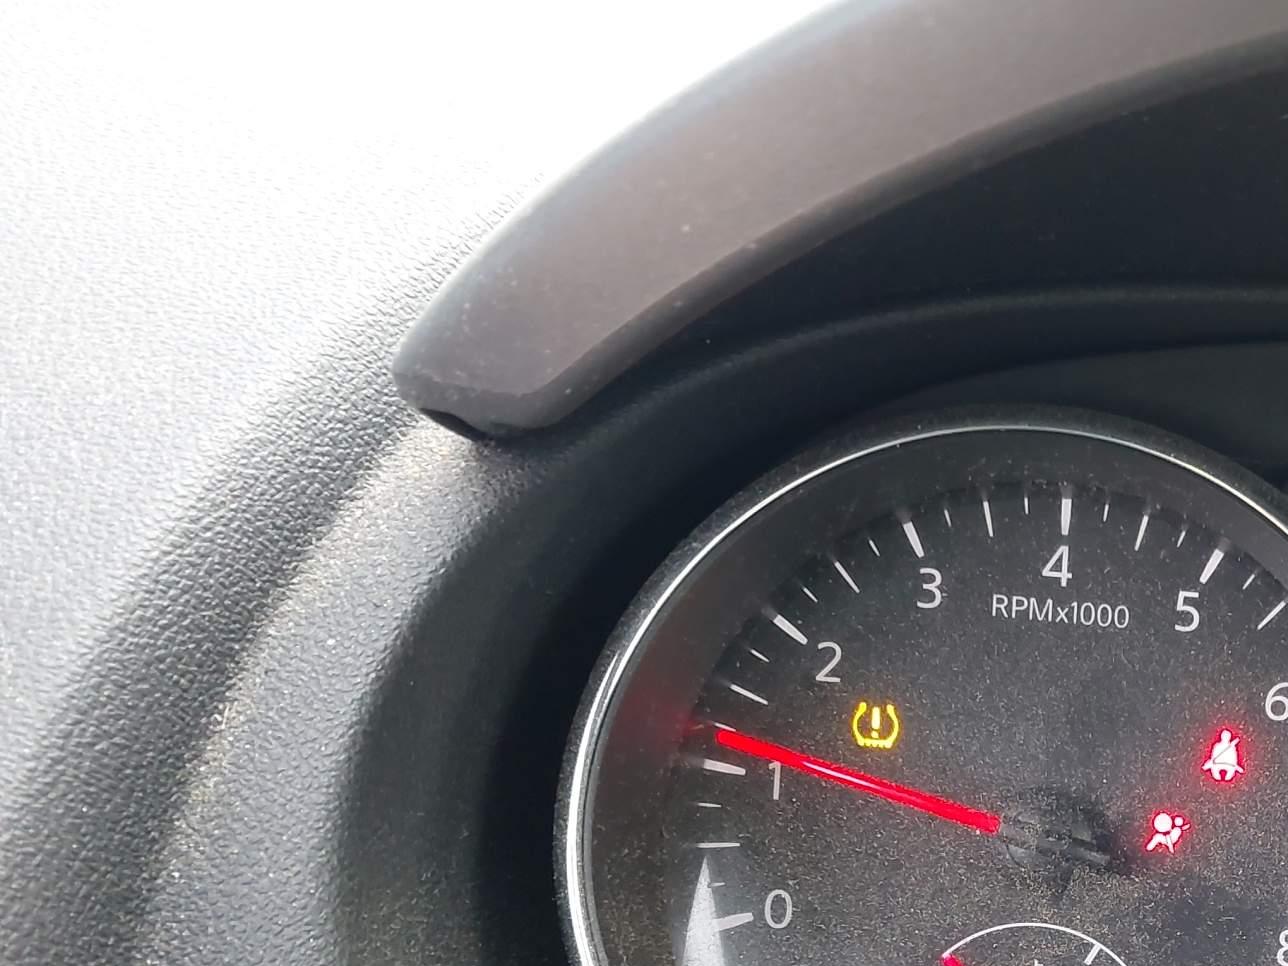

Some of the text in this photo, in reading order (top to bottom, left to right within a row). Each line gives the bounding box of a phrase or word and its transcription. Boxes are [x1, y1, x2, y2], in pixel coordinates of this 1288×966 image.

[1042, 546, 1073, 586] 4
[917, 569, 943, 609] 3
[991, 595, 1130, 629] RPMx1000
[1174, 591, 1201, 632] 5
[815, 643, 843, 685] 2
[768, 760, 782, 801] 1
[763, 890, 793, 929] 0
